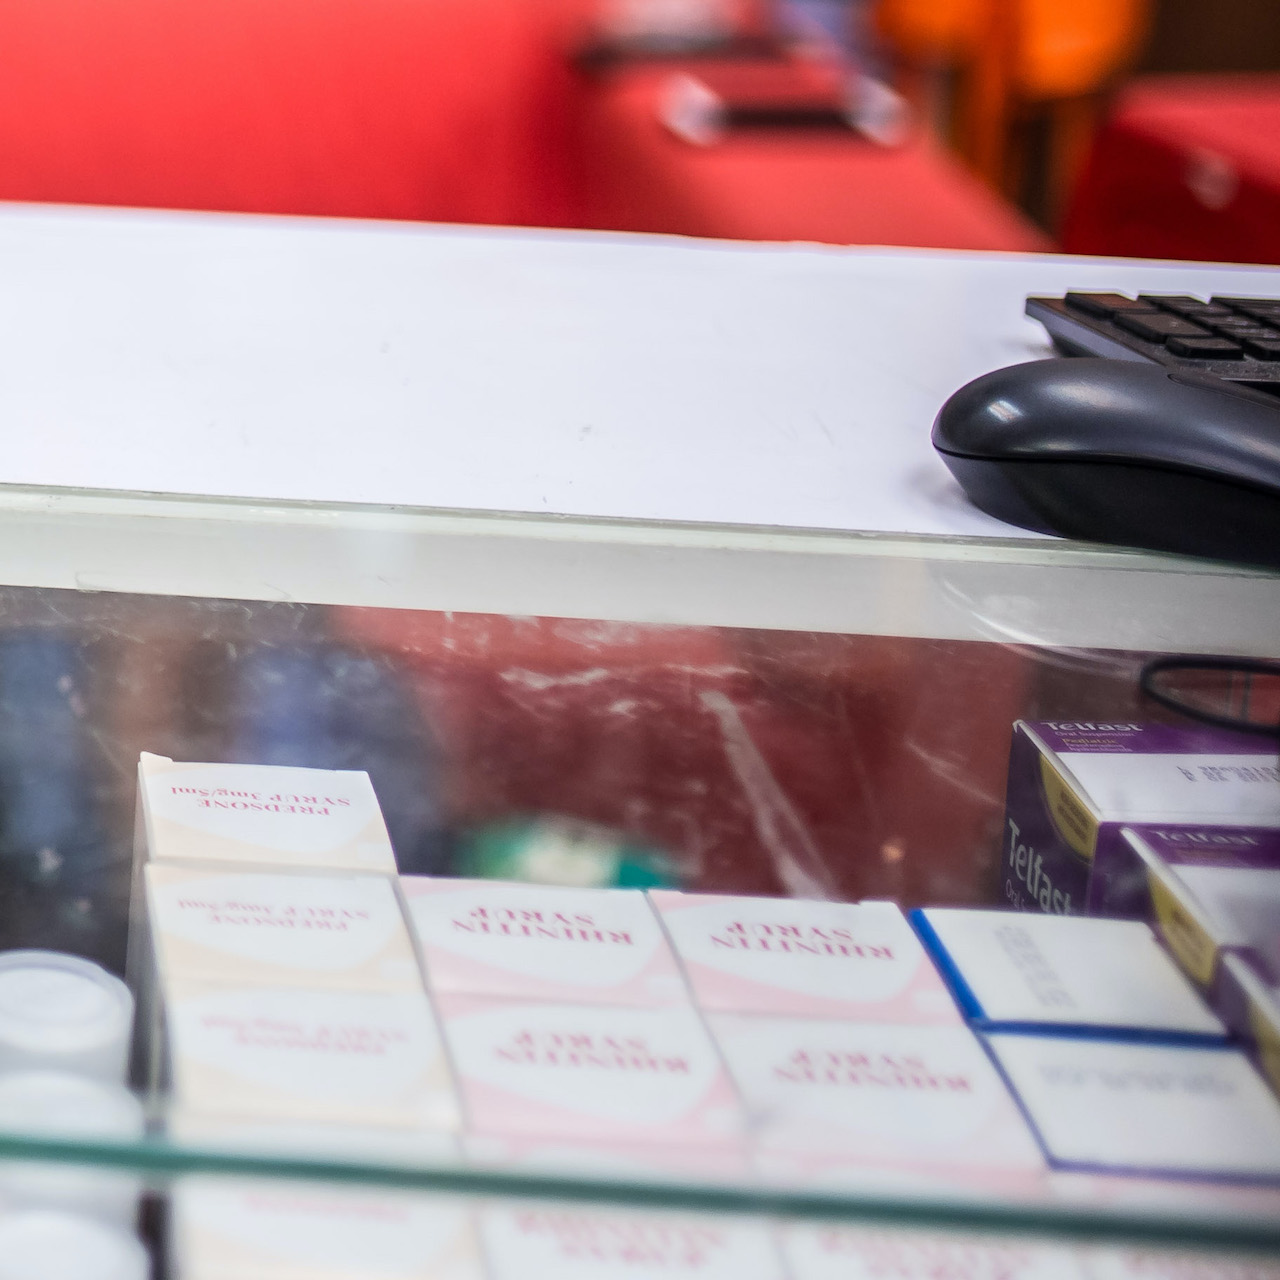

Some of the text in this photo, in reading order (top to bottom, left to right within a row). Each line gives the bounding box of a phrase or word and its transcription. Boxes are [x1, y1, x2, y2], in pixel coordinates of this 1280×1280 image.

[1041, 721, 1144, 733] Telfast
[171, 786, 351, 807] SYRUP 3mg/5ml
[198, 799, 330, 816] PREDSONE
[1149, 830, 1260, 846] Telfast
[470, 906, 595, 926] SYRUP
[726, 921, 853, 941] SYRUP
